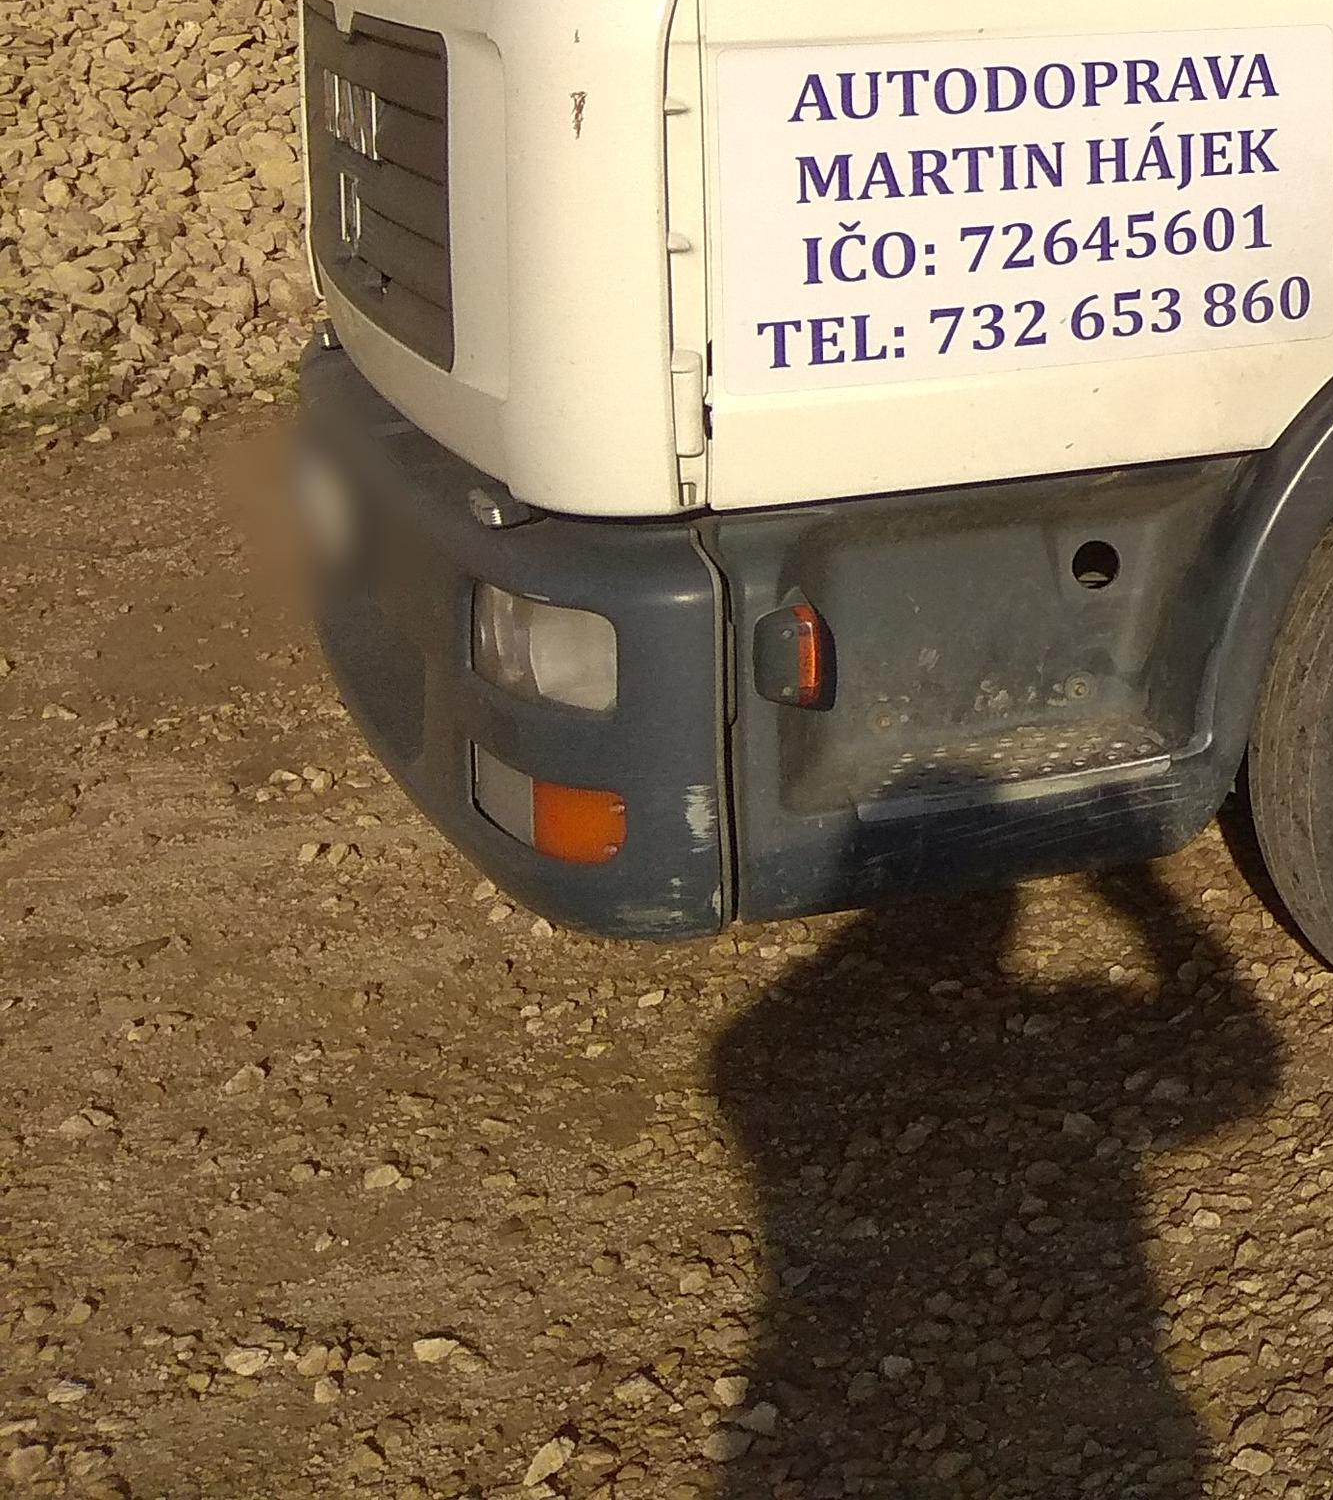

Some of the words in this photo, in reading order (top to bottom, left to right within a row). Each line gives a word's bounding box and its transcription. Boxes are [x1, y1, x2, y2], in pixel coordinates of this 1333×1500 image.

[787, 53, 1280, 123] AUTODOPRAVA
[794, 141, 1066, 204] MARTIN
[1085, 121, 1280, 191] HÁJEK
[802, 220, 937, 285] IČO:
[959, 203, 1273, 273] 72645601
[756, 314, 906, 369] TEL:
[929, 299, 1047, 355] 732
[1070, 287, 1182, 341] 653
[1203, 275, 1311, 328] 860
